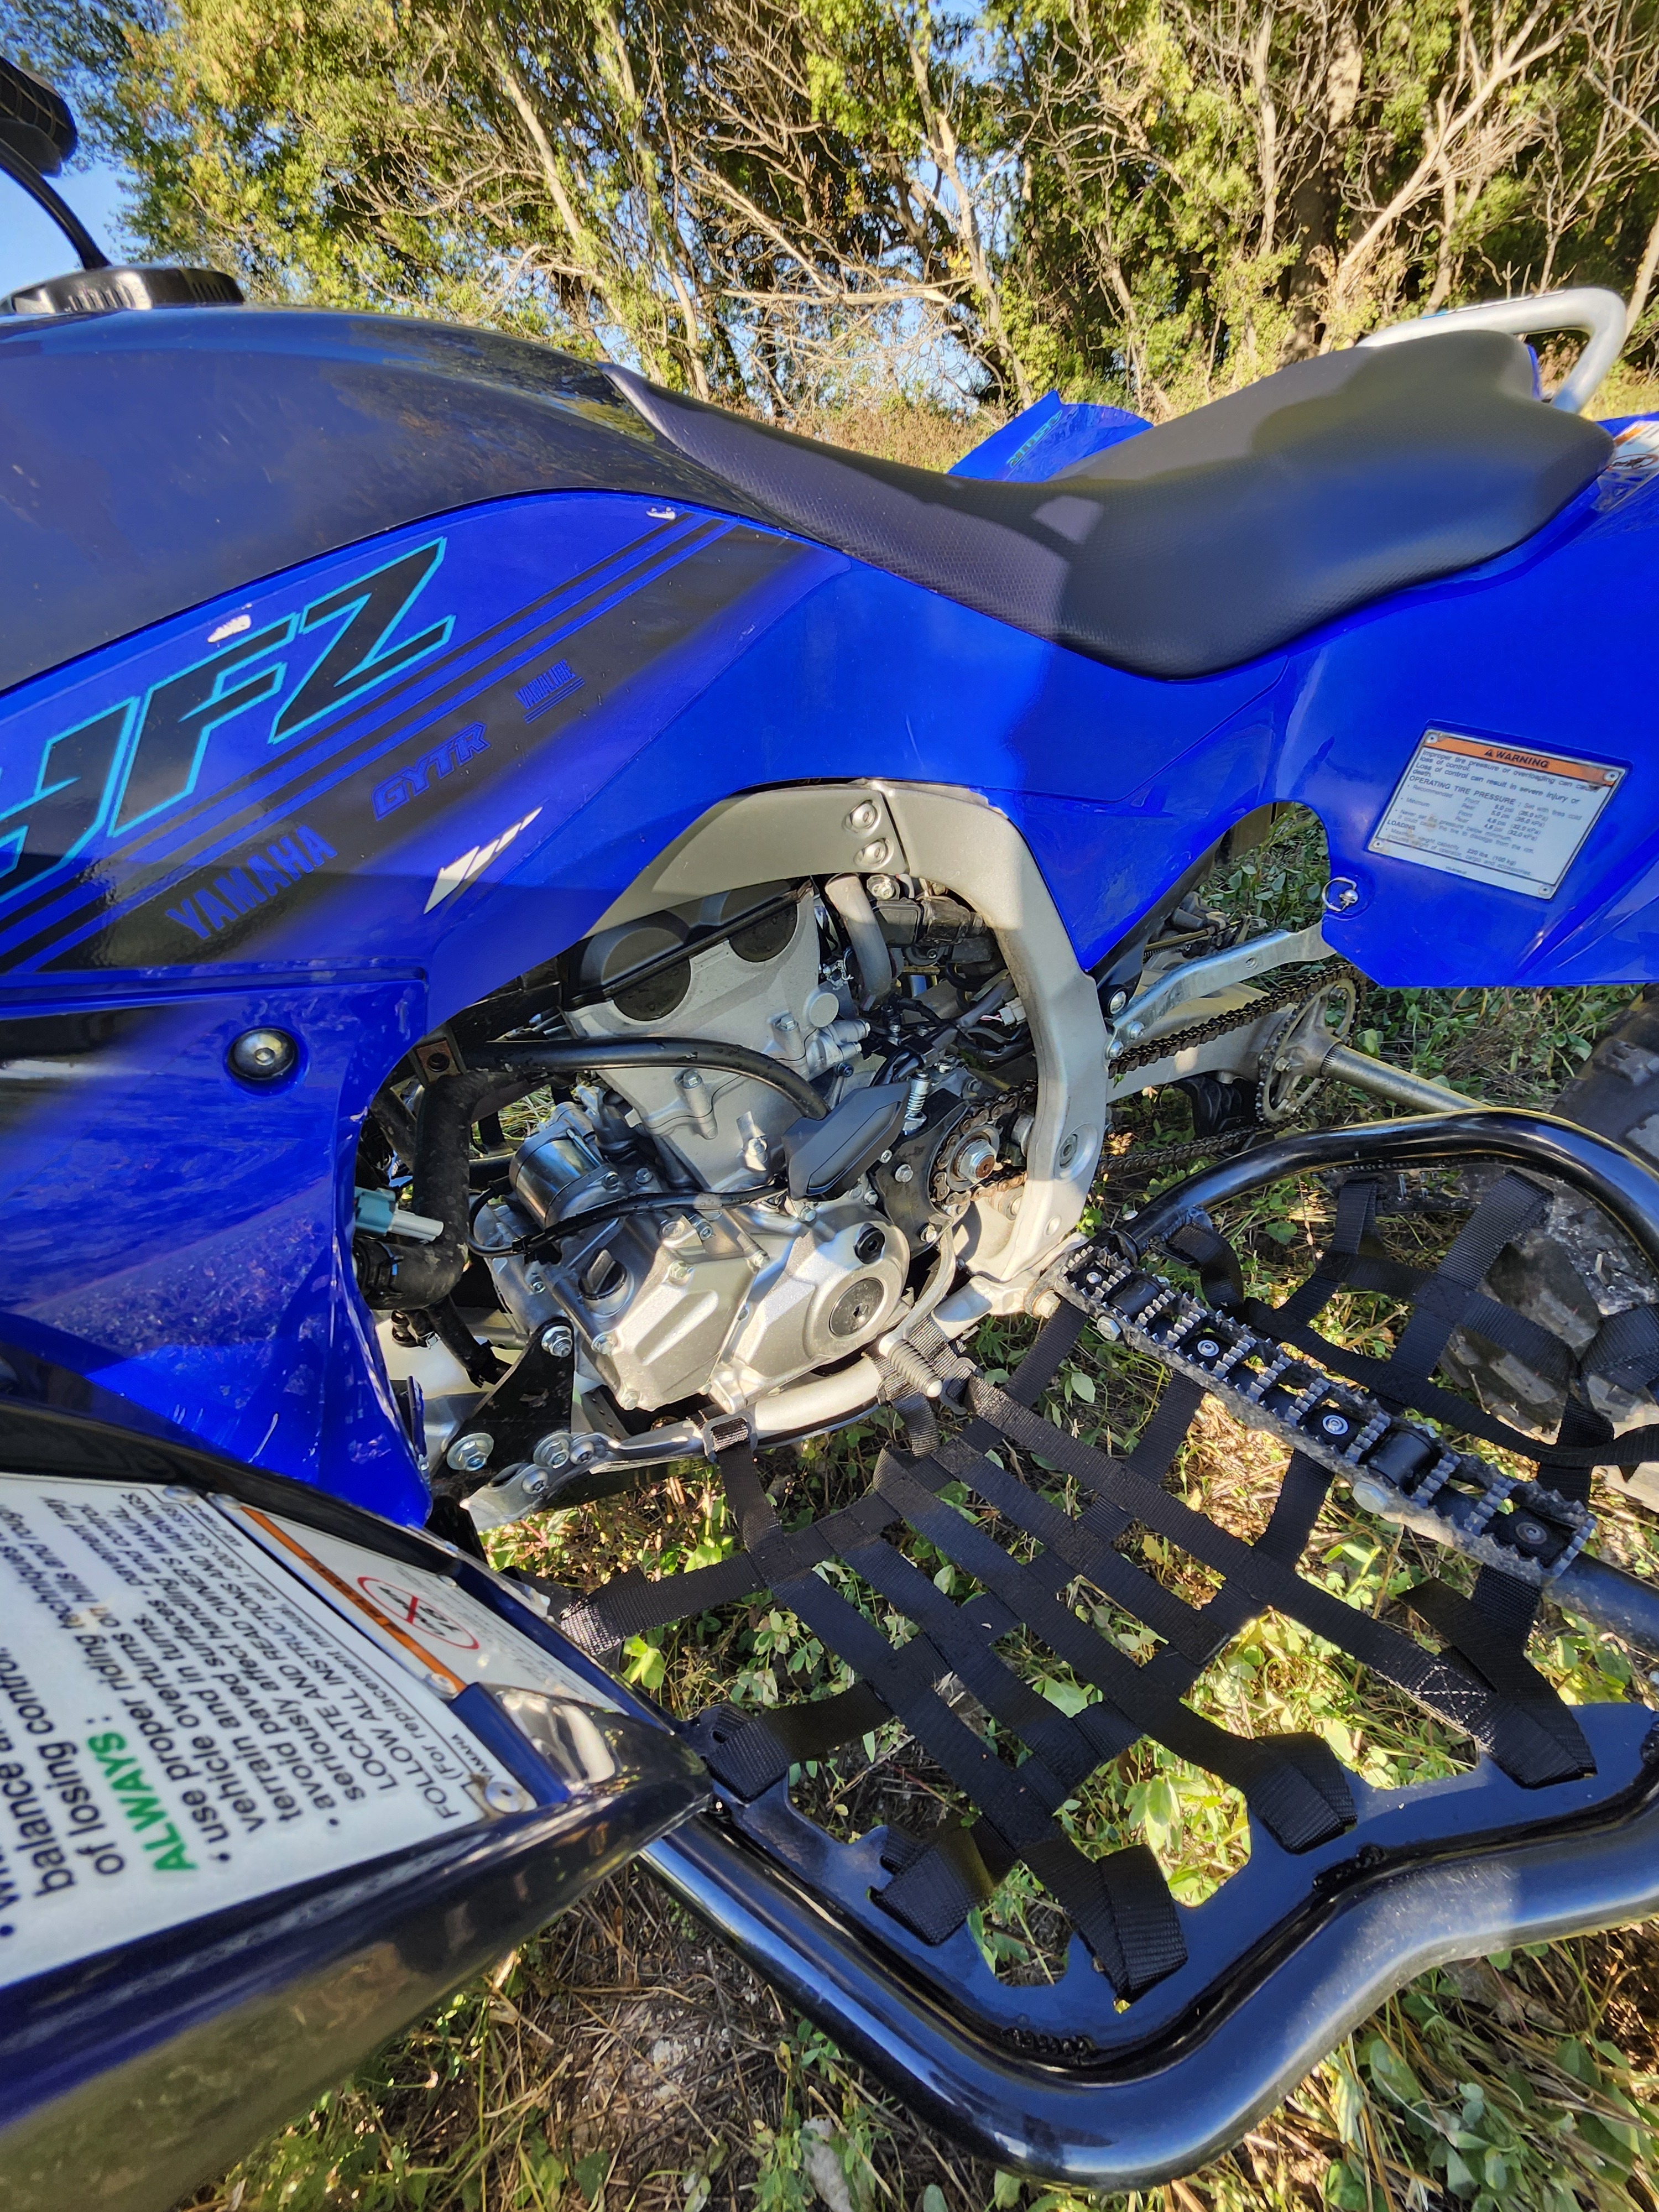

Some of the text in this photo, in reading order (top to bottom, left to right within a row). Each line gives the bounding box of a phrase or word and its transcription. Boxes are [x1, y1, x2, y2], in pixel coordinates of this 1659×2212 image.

[372, 721, 491, 821] GYTR
[1422, 750, 1452, 761] Improper
[1468, 761, 1499, 771] pressure
[1514, 771, 1556, 784] overloading
[1496, 751, 1550, 768] WARNING
[1410, 776, 1451, 789] OPERATING
[1455, 786, 1471, 794] TIRE
[1474, 790, 1516, 805] PRESSURE
[1546, 792, 1568, 802] injury
[1387, 820, 1416, 830] LOADING
[166, 824, 338, 940] YAMAHA
[42, 1498, 75, 1520] may
[21, 1544, 66, 1568] and
[65, 1524, 151, 1585] pavement
[119, 1551, 160, 1574] and
[189, 1556, 227, 1579] AND
[56, 1573, 97, 1602] hills
[154, 1579, 228, 1639] handling
[161, 1558, 238, 1616] OWNER'S
[244, 1582, 277, 1600] call
[90, 1608, 121, 1627] on
[148, 1600, 225, 1667] surfaces
[220, 1584, 345, 1685] INSTRUCTIONS
[231, 1621, 285, 1660] READ
[273, 1604, 332, 1647] manual,
[74, 1635, 133, 1691] riding
[111, 1634, 200, 1728] overturns
[220, 1645, 280, 1691] affect
[279, 1665, 325, 1699] AND
[133, 1614, 302, 1822] terrain and in turns.
[211, 1674, 288, 1734] paved
[326, 1651, 425, 1738] replacement
[342, 1689, 381, 1720] ALL
[121, 1699, 210, 1781] proper
[273, 1699, 365, 1801] seriously
[316, 1705, 398, 1790] LOCATE
[422, 1746, 463, 1781] (For
[452, 1734, 494, 1781] YAMAHA
[37, 1742, 105, 1837] losing
[192, 1736, 265, 1832] vehicle
[267, 1742, 336, 1809] avoid
[371, 1729, 460, 1819] FOLLOW
[87, 1733, 196, 1871] ALWAYS
[181, 1790, 229, 1843] use
[0, 1762, 76, 1897] balance
[76, 1843, 124, 1875] of
